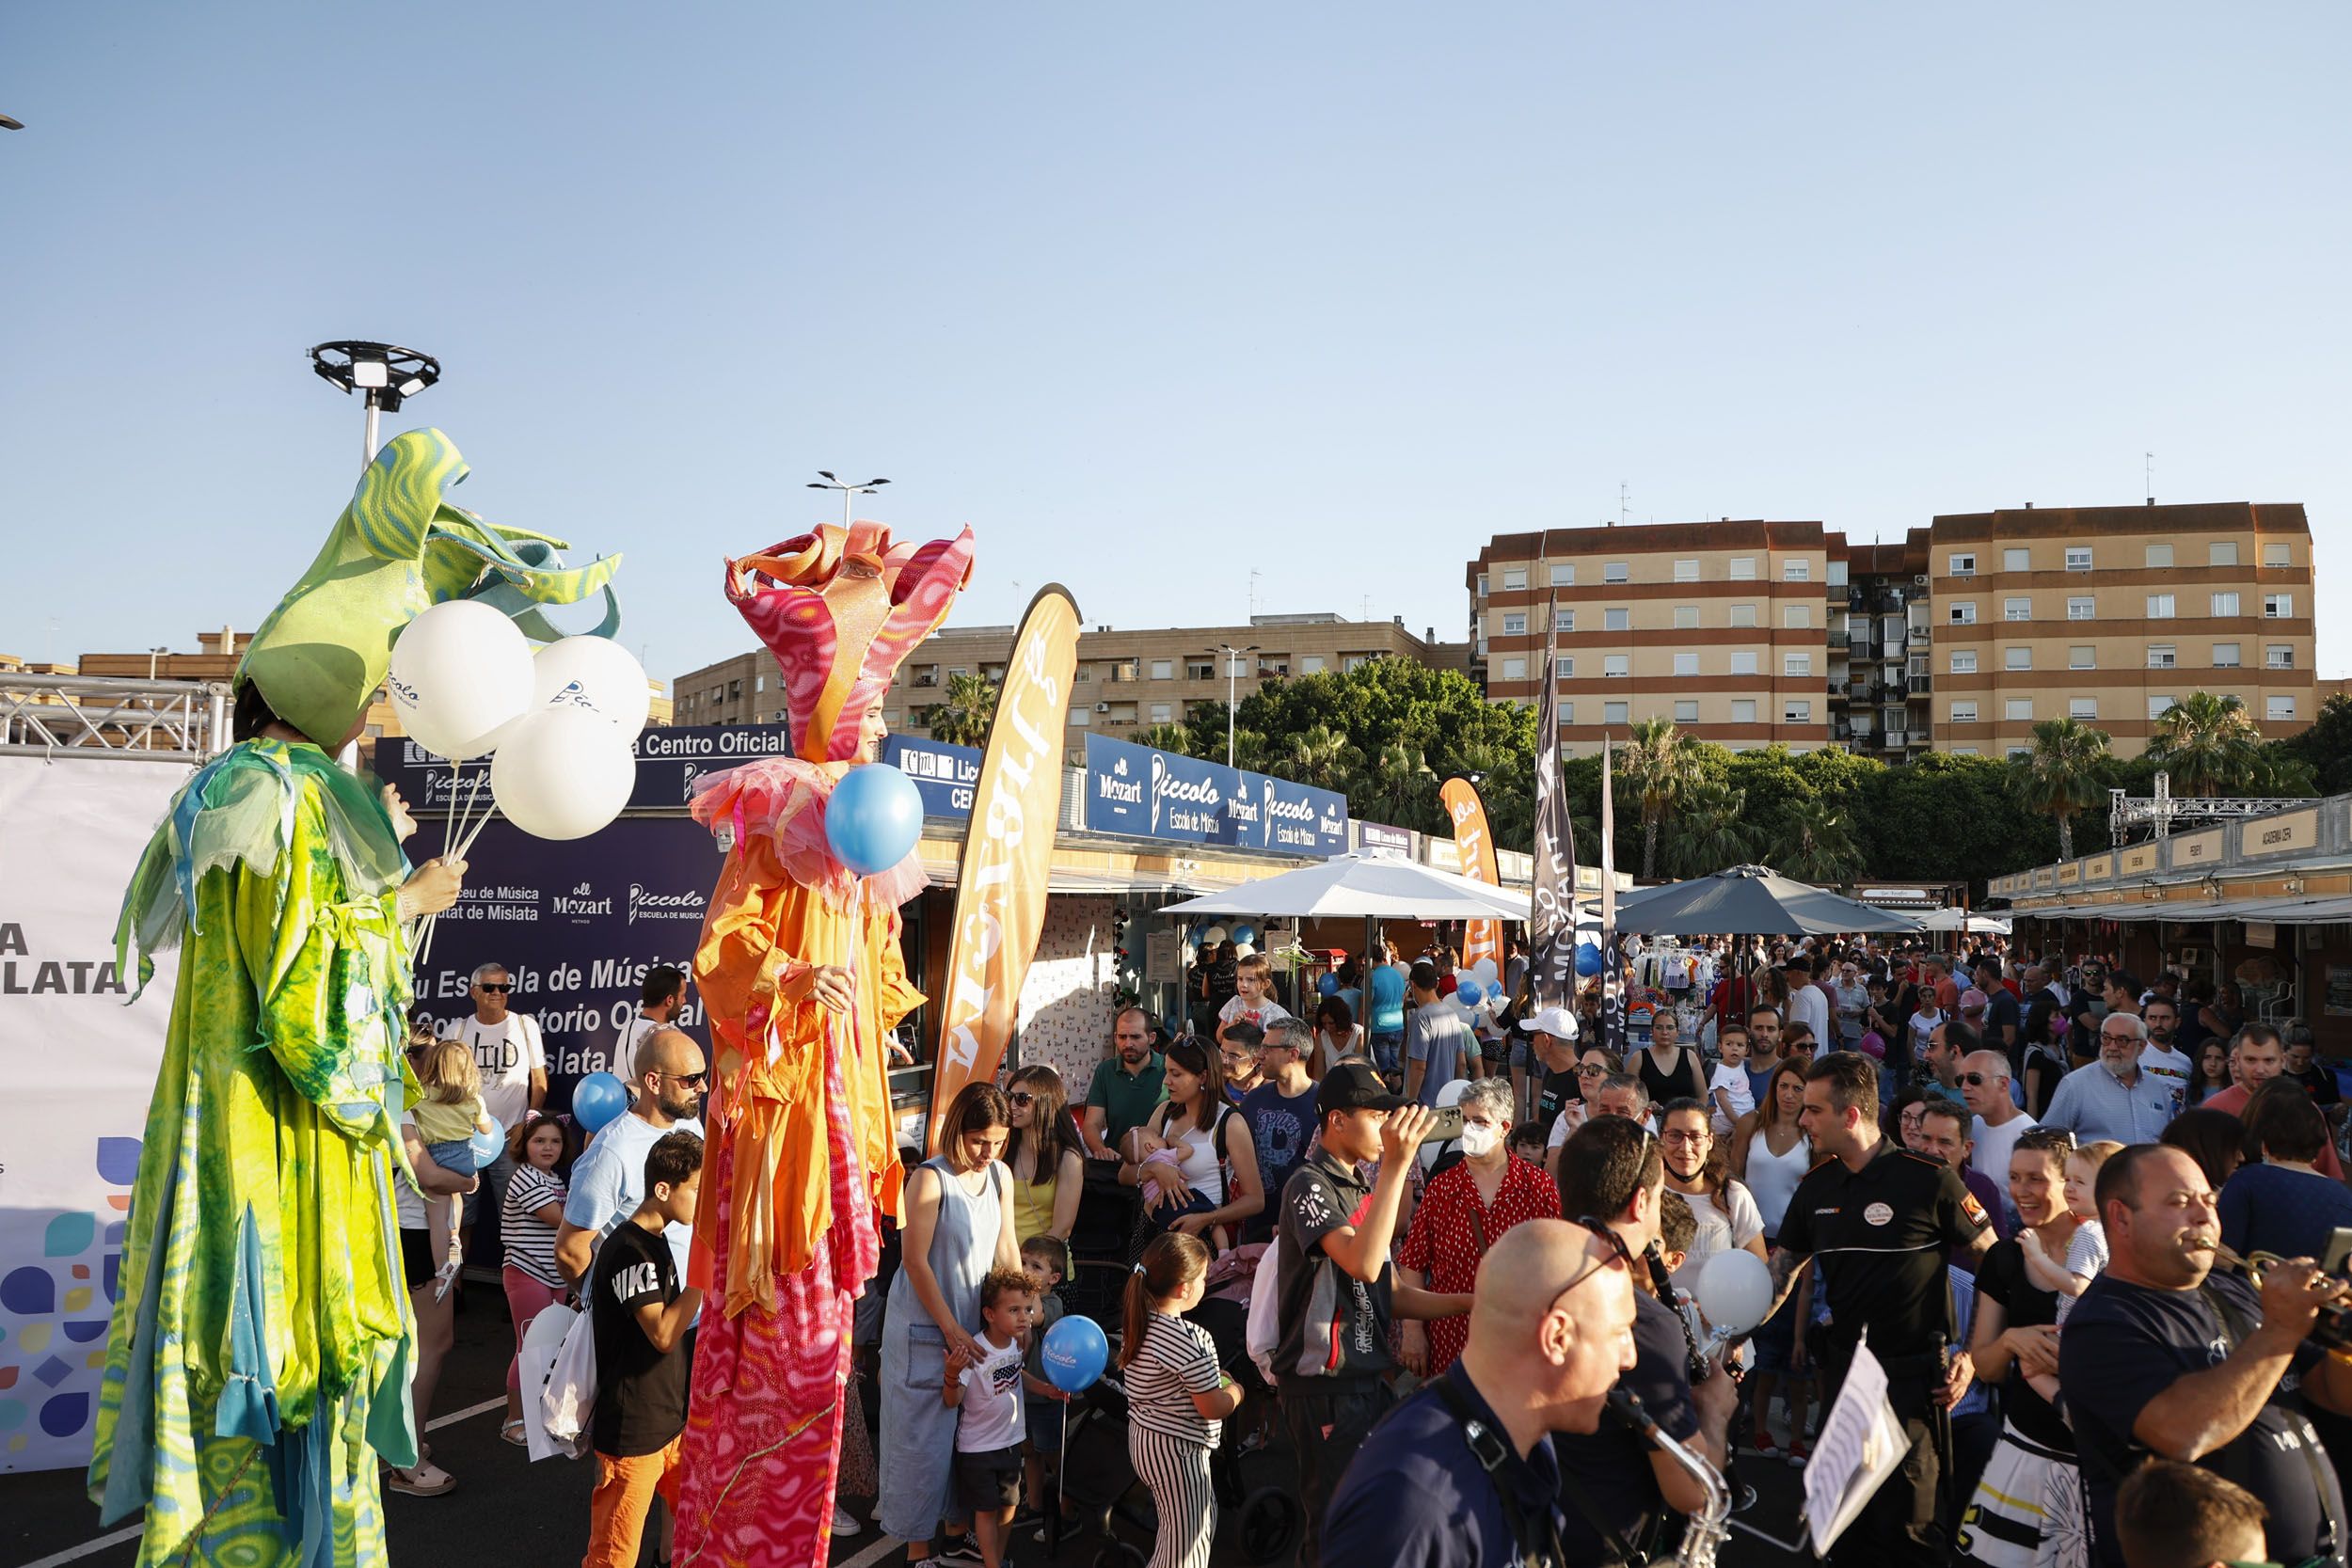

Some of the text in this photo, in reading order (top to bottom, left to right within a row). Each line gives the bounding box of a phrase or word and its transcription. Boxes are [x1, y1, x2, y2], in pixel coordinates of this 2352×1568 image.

[646, 735, 713, 755] Centro
[719, 731, 786, 752] Oficial
[1099, 774, 1142, 804] Mozart
[1152, 753, 1220, 834] Piccolo
[1228, 799, 1258, 822] Mozart
[1263, 779, 1315, 847] Piccolo
[1320, 816, 1343, 835] Mozart
[478, 886, 495, 899] de
[497, 885, 539, 900] Música
[573, 882, 591, 895] all
[467, 906, 485, 920] de
[486, 905, 538, 921] Mislata
[552, 895, 612, 915] Mozart
[628, 883, 707, 927] Piccolo
[679, 911, 705, 920] MUSICA
[413, 956, 692, 1000] u Esela de Músa
[1298, 1193, 1326, 1215] INDIANA
[1305, 1209, 1331, 1228] PACERS
